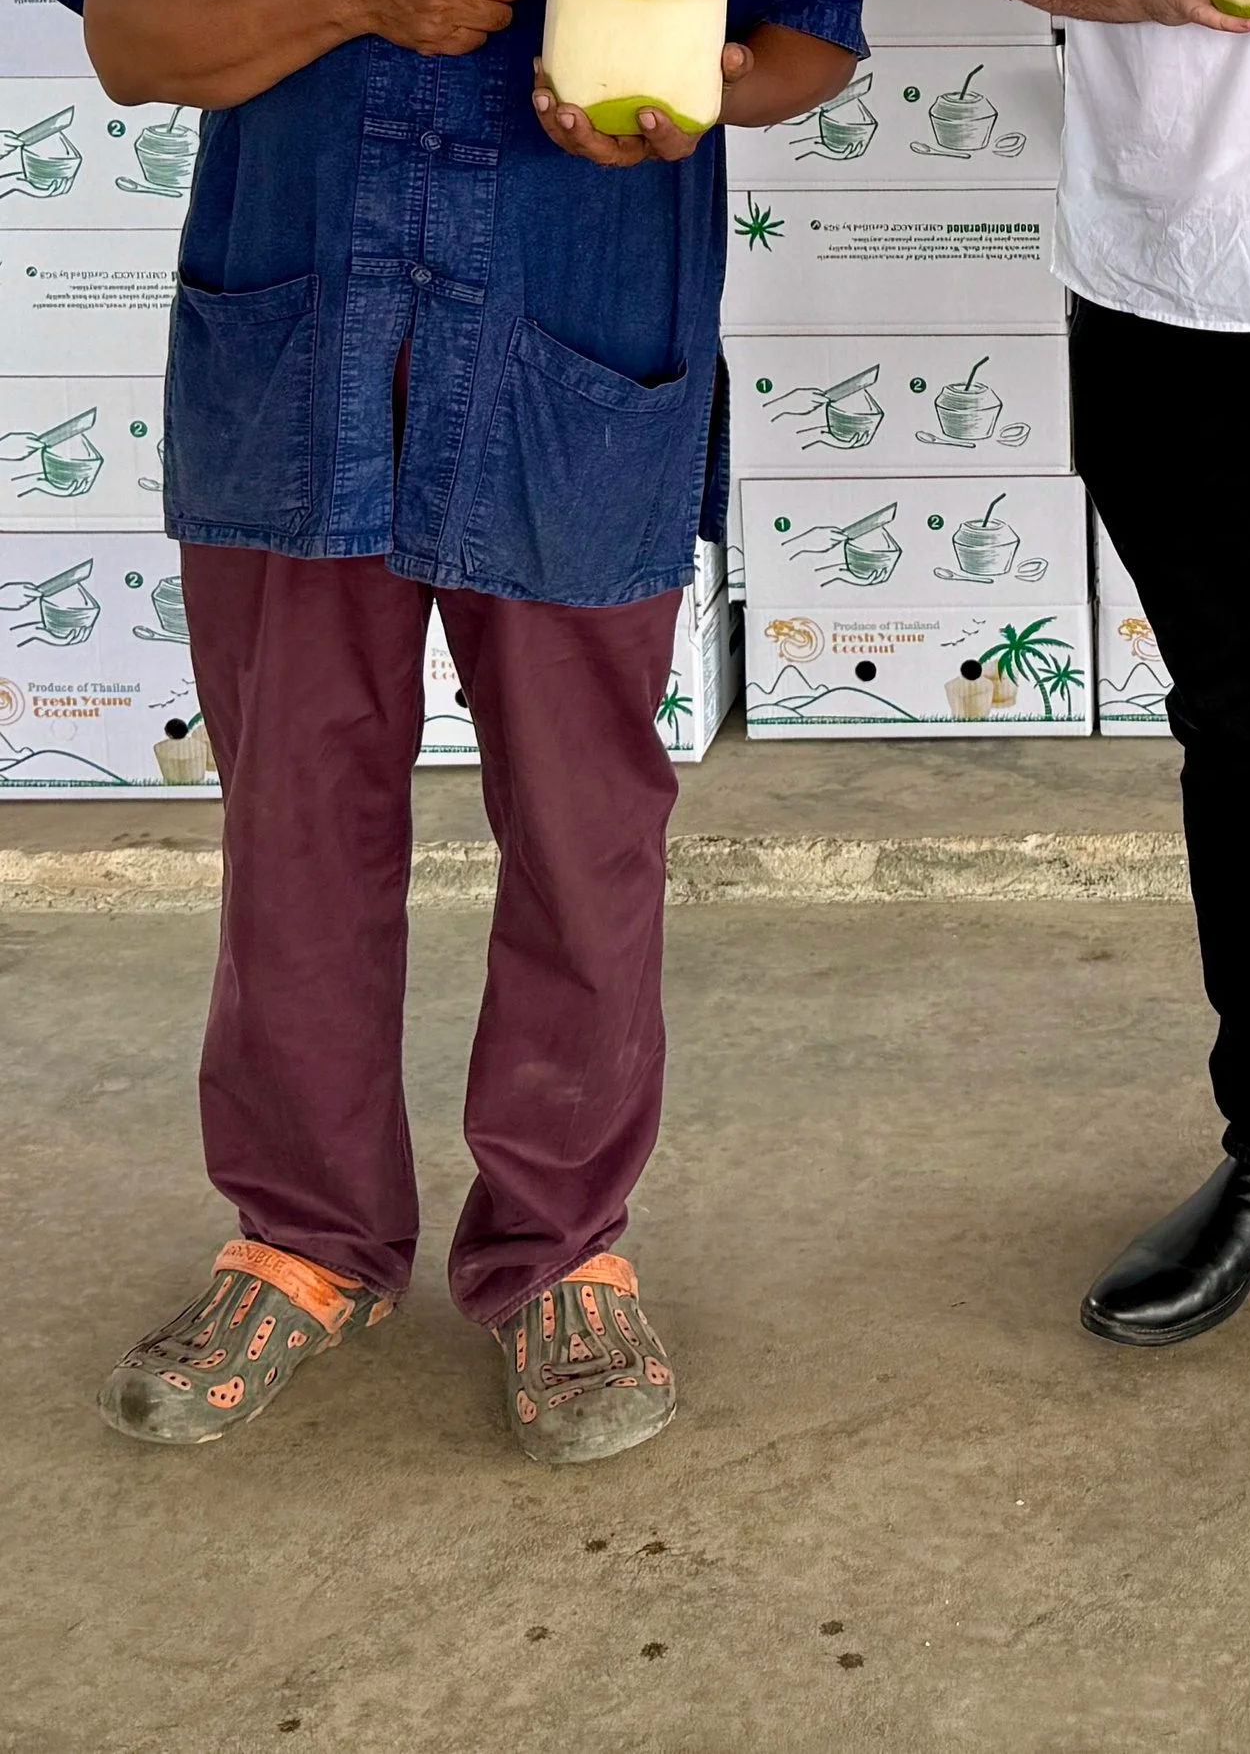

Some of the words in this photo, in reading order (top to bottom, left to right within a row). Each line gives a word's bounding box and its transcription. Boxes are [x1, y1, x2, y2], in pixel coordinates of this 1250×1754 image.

[947, 224, 1012, 233] Refrigerated
[1014, 223, 1039, 233] Keep
[59, 270, 69, 279] by
[833, 622, 876, 630] Produce
[880, 622, 889, 630] of
[894, 621, 940, 630] Thailand
[832, 633, 874, 643] Fresh
[878, 633, 924, 642] Young
[832, 644, 895, 653] Coconut
[28, 683, 73, 692] Produce
[77, 683, 87, 692] of
[91, 683, 140, 692] Thailand
[33, 696, 77, 706] Fresh
[81, 696, 131, 706] Young
[34, 707, 100, 718] Coconut
